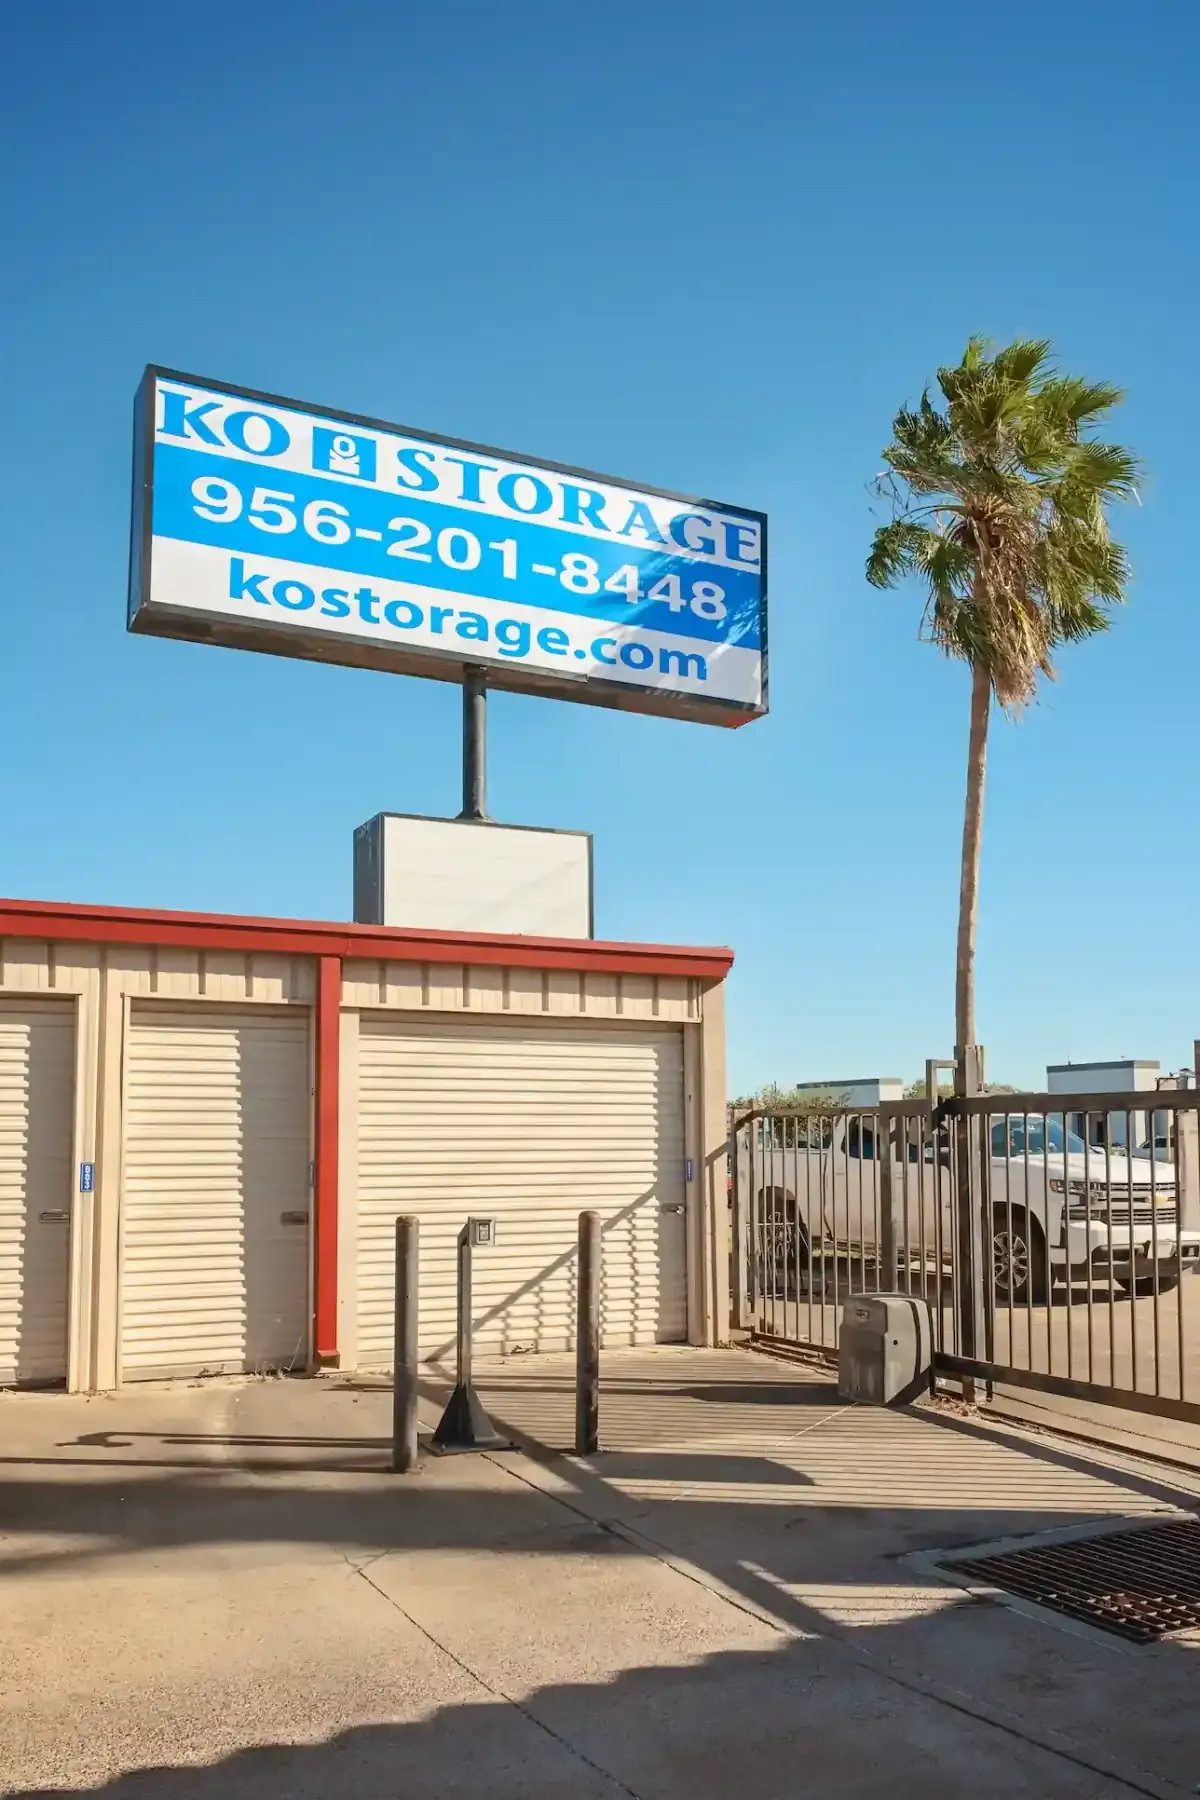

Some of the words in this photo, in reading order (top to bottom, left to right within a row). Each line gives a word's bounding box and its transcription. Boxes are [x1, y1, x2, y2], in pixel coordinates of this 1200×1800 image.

[157, 389, 291, 457] KO
[397, 447, 760, 566] STORAGE
[191, 476, 728, 621] 956-201-8448
[229, 557, 707, 680] kostorage.com
